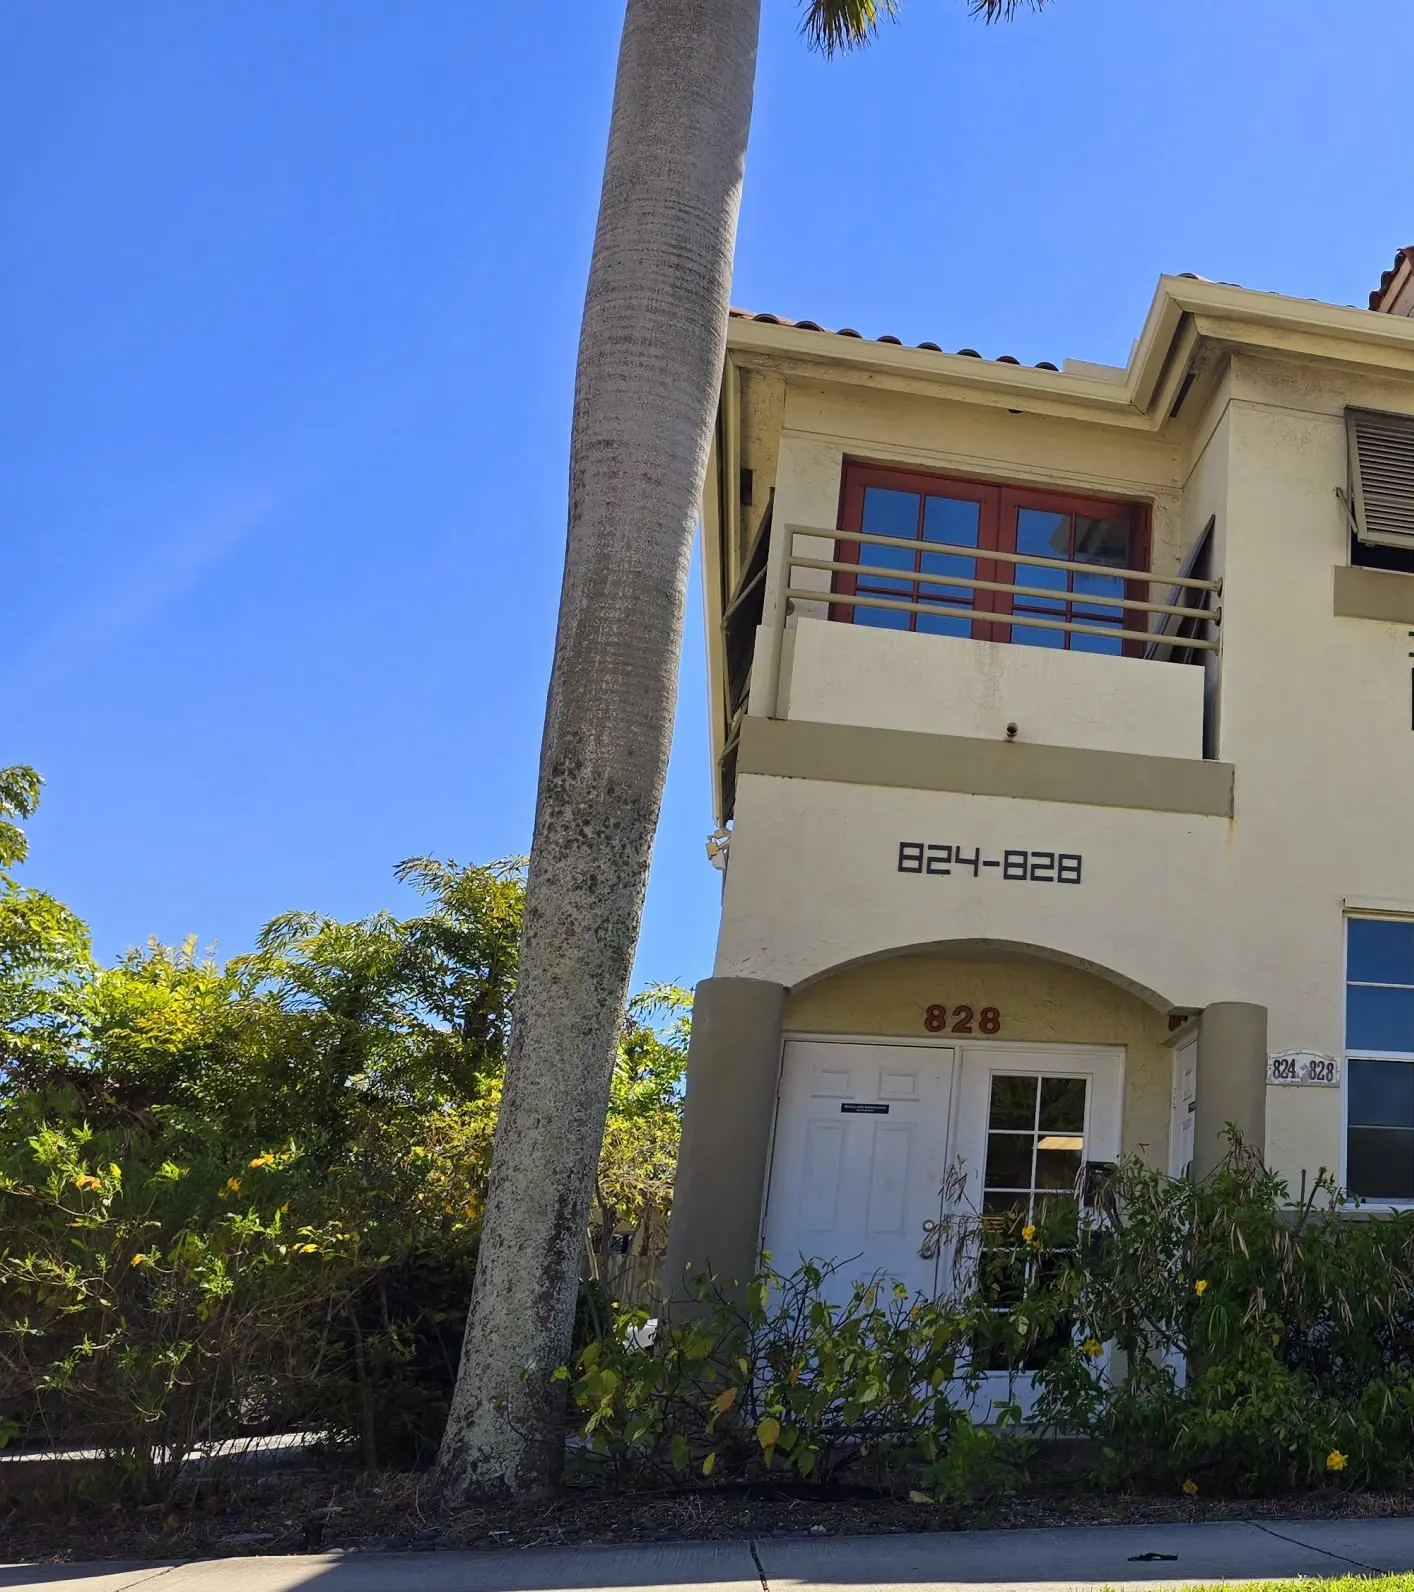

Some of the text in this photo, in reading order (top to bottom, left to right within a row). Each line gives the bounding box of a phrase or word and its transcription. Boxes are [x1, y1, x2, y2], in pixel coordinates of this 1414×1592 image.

[898, 841, 1082, 884] 824-828
[924, 1004, 1001, 1034] 828
[1273, 1059, 1334, 1082] 824 828
